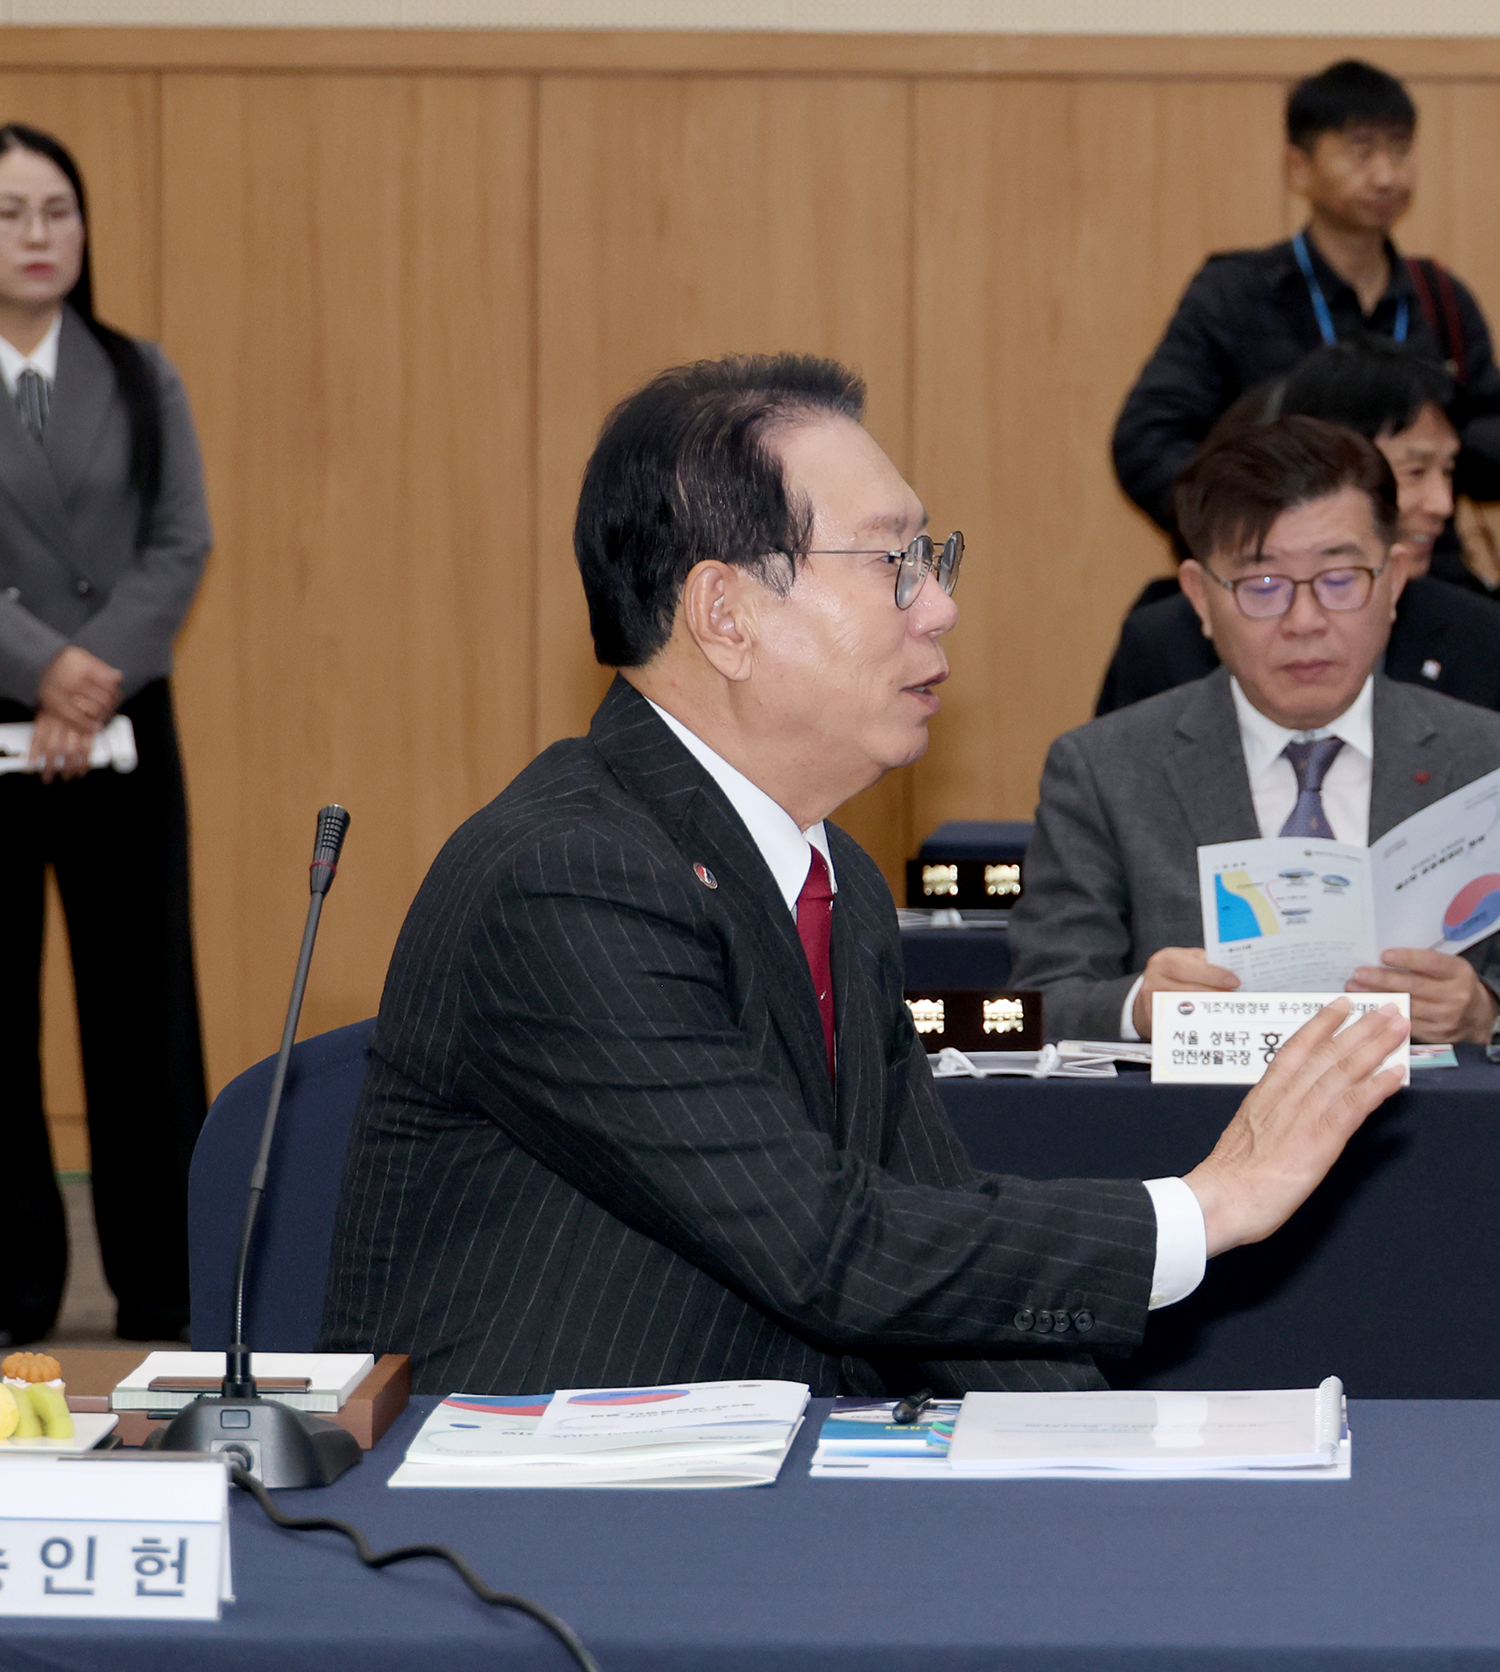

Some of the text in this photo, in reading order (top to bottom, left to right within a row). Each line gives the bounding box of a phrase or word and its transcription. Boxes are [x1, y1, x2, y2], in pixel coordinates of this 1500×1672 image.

[1173, 1030, 1251, 1046] 서울 성북구
[1172, 1049, 1251, 1066] 안전생활국장
